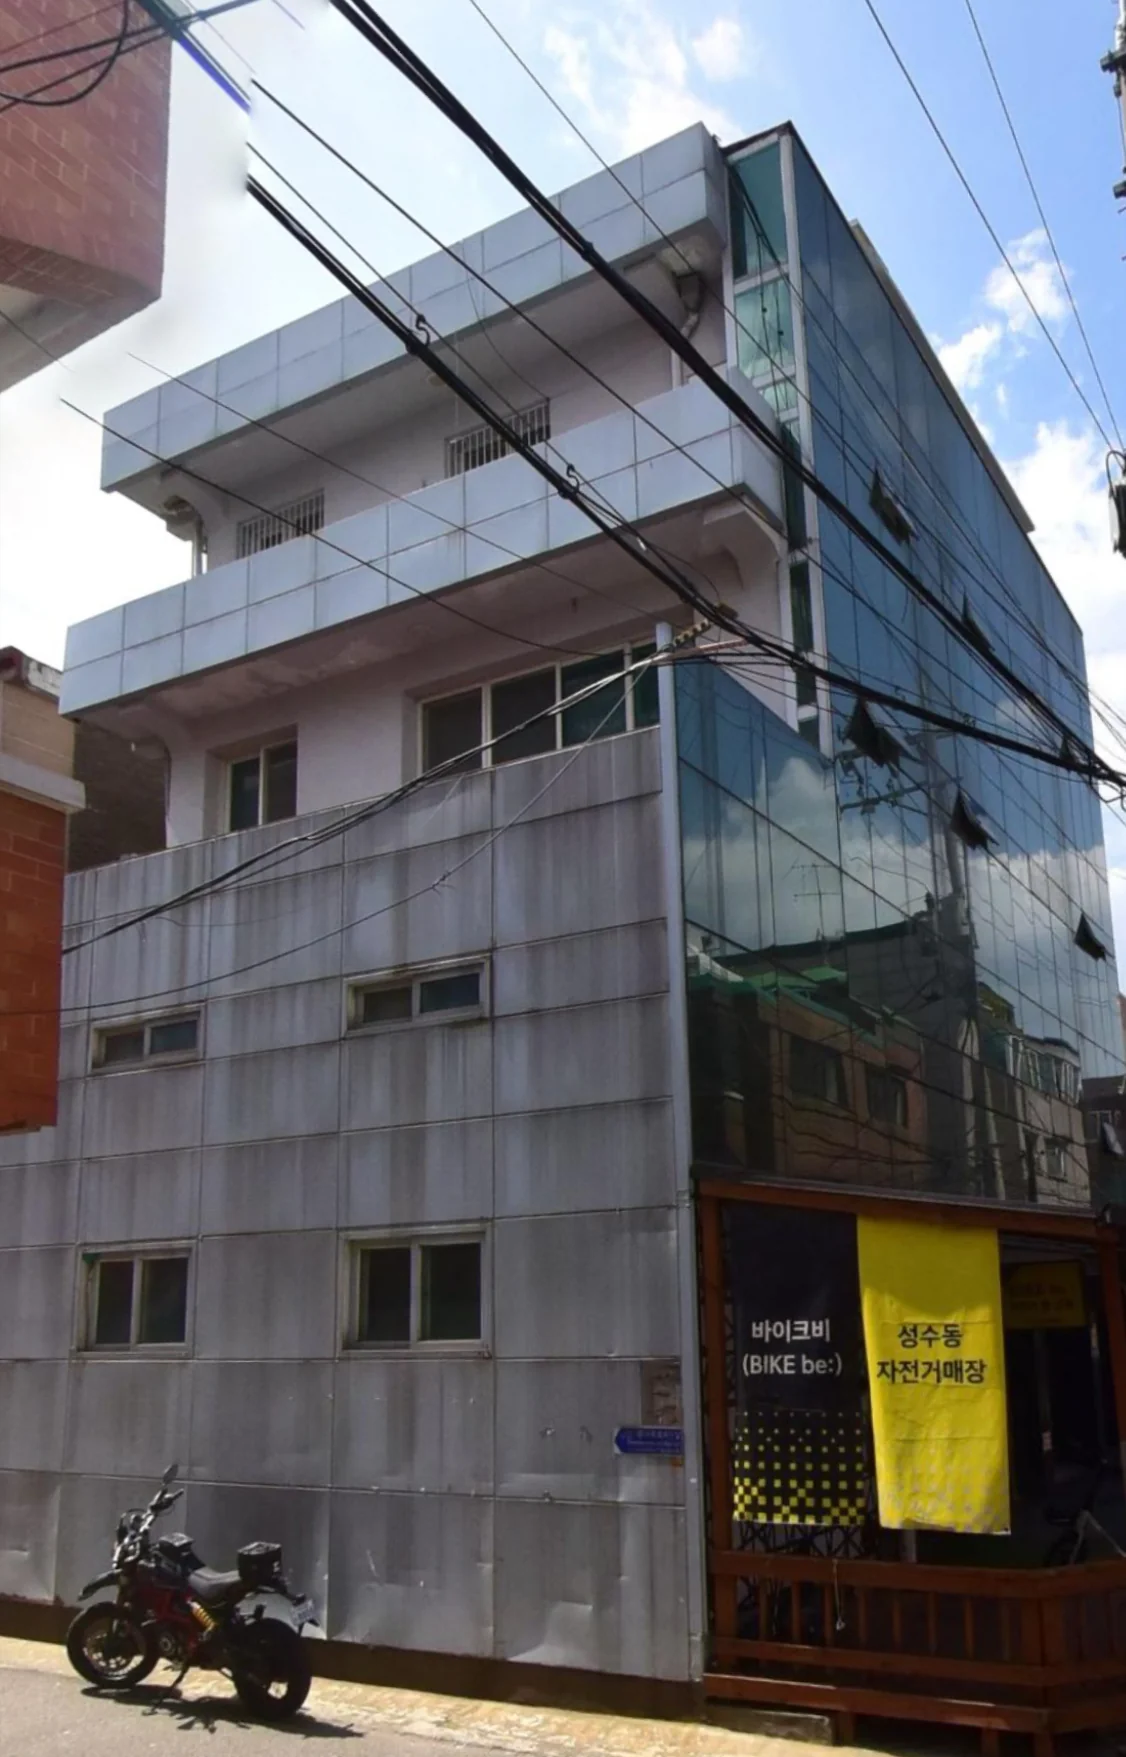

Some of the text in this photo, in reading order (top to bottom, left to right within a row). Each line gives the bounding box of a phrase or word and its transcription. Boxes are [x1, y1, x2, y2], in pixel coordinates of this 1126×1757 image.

[752, 1318, 831, 1343] 바이크비
[898, 1323, 963, 1348] 성수동
[743, 1352, 842, 1376] (BIKE be:)
[876, 1359, 988, 1384] 자전거매장
